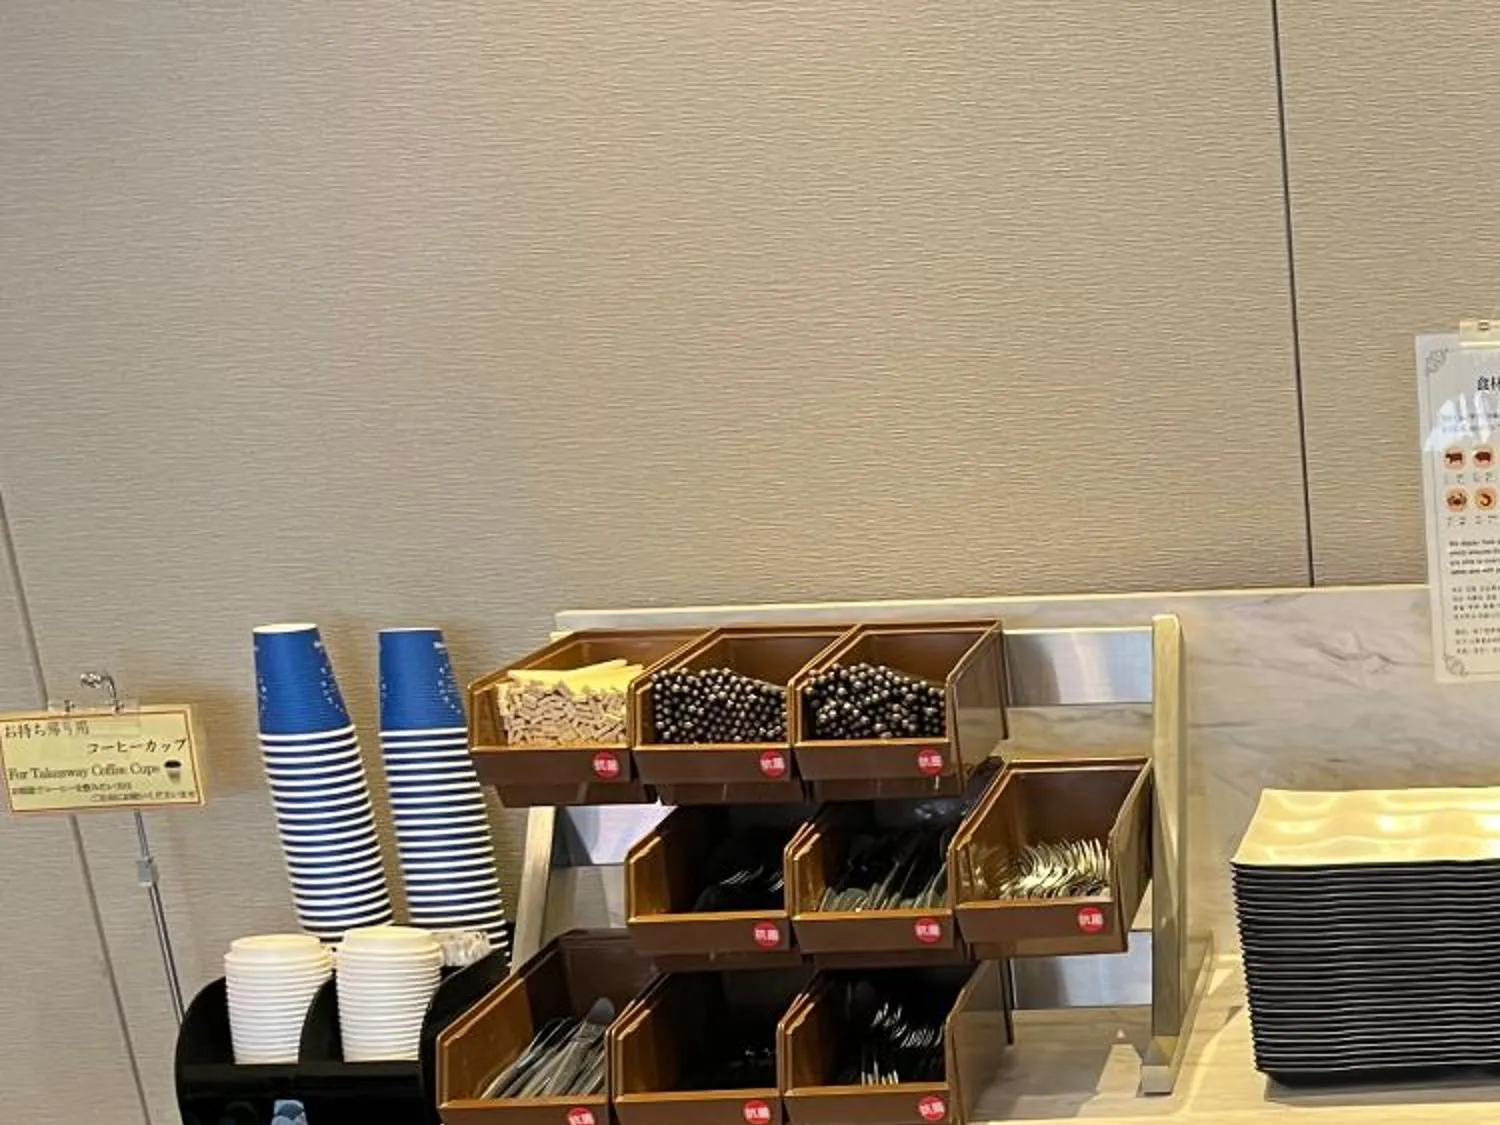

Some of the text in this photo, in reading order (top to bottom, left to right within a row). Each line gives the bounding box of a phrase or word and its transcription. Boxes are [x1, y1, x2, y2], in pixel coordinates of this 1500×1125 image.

[8, 766, 28, 781] For
[91, 763, 127, 777] Coffee
[129, 762, 161, 777] Cups
